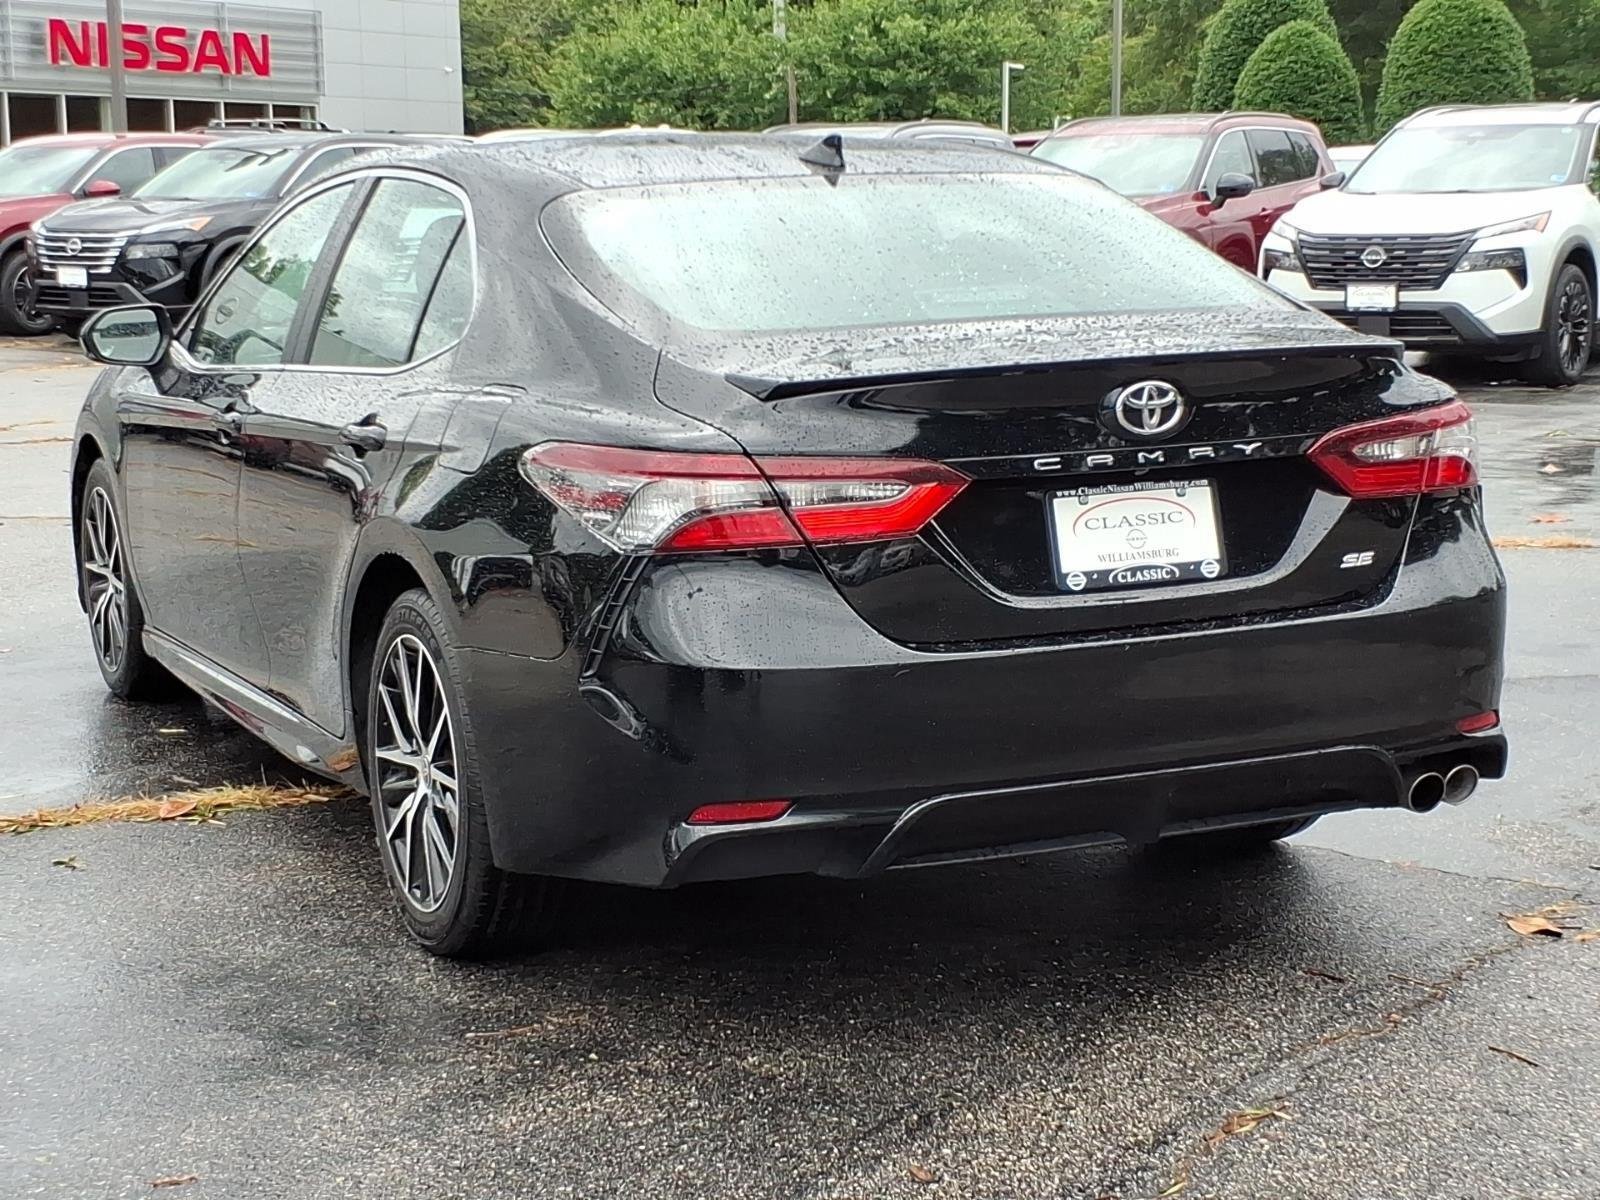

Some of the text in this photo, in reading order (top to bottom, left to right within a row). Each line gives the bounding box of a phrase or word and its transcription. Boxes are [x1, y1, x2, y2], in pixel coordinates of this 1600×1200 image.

[48, 19, 270, 77] NISSAN
[1033, 442, 1262, 470] CAMRY
[1056, 478, 1209, 498] www.ClassicNissanWilliamsburg.com
[1084, 511, 1184, 531] CLASSIC
[1097, 547, 1180, 563] WILLIAMSBURG
[1339, 550, 1374, 568] SE
[1117, 567, 1172, 583] CLASSIC
